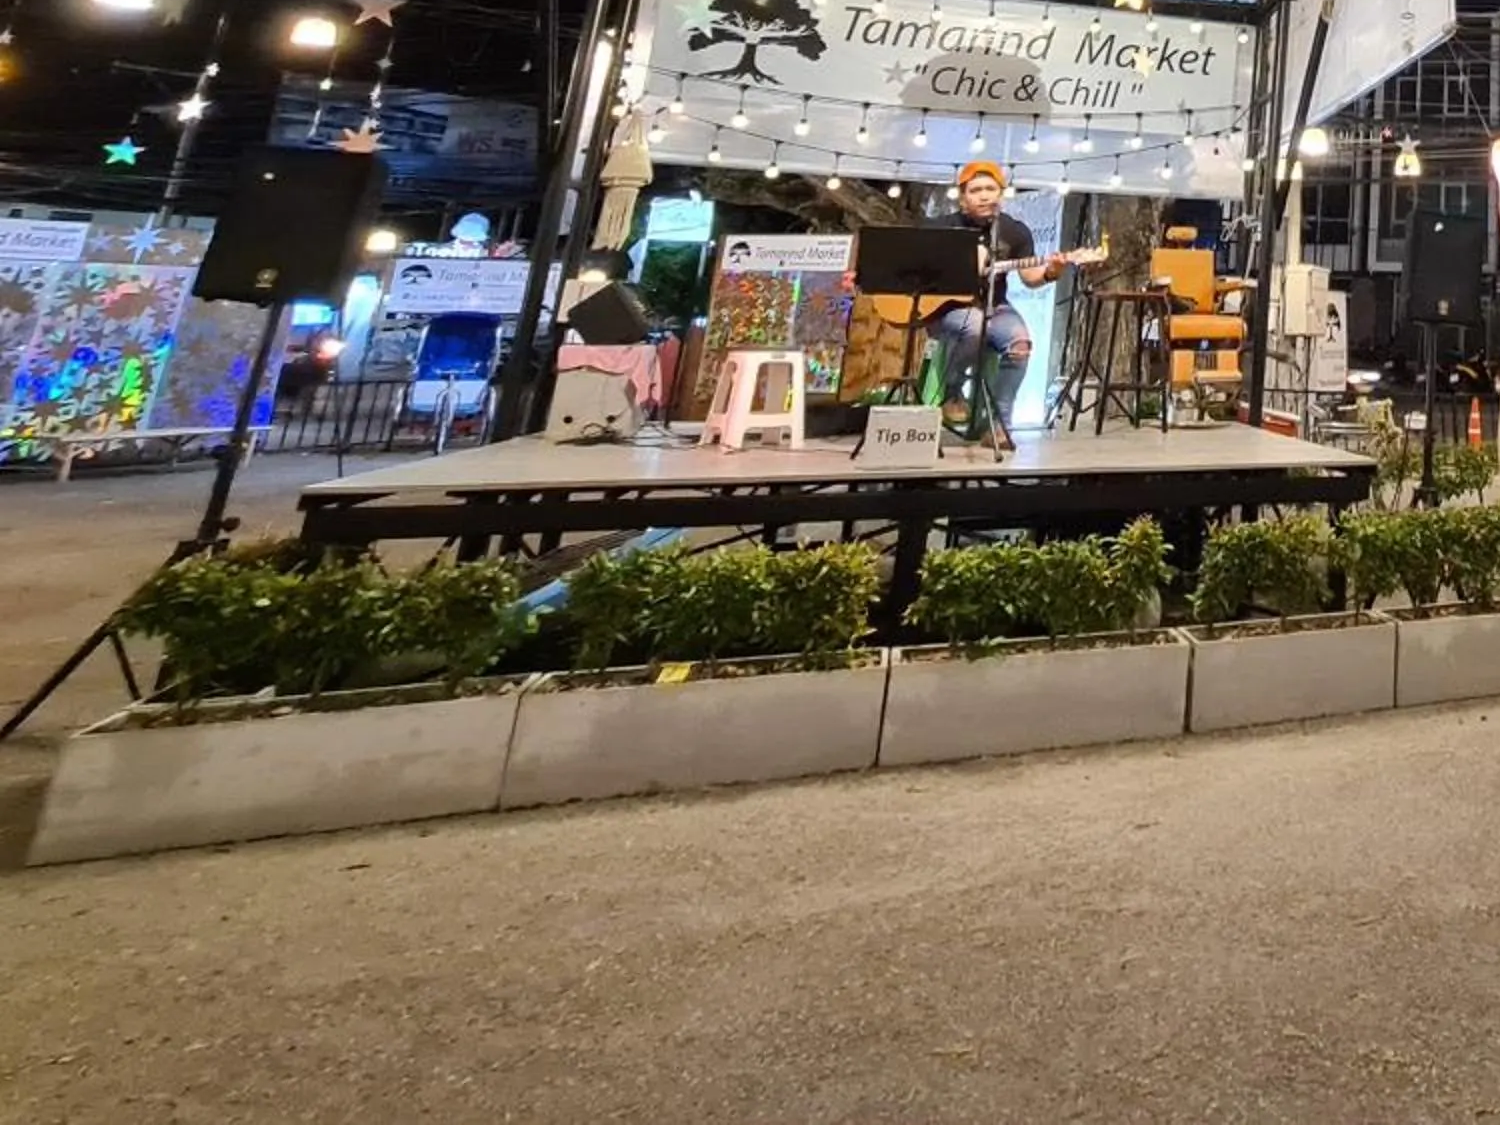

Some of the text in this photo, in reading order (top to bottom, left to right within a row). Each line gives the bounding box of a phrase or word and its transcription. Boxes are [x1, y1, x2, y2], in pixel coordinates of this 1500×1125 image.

[844, 5, 1217, 76] Tamarind Market
[1013, 73, 1039, 103] &
[877, 427, 937, 446] Tip Box
